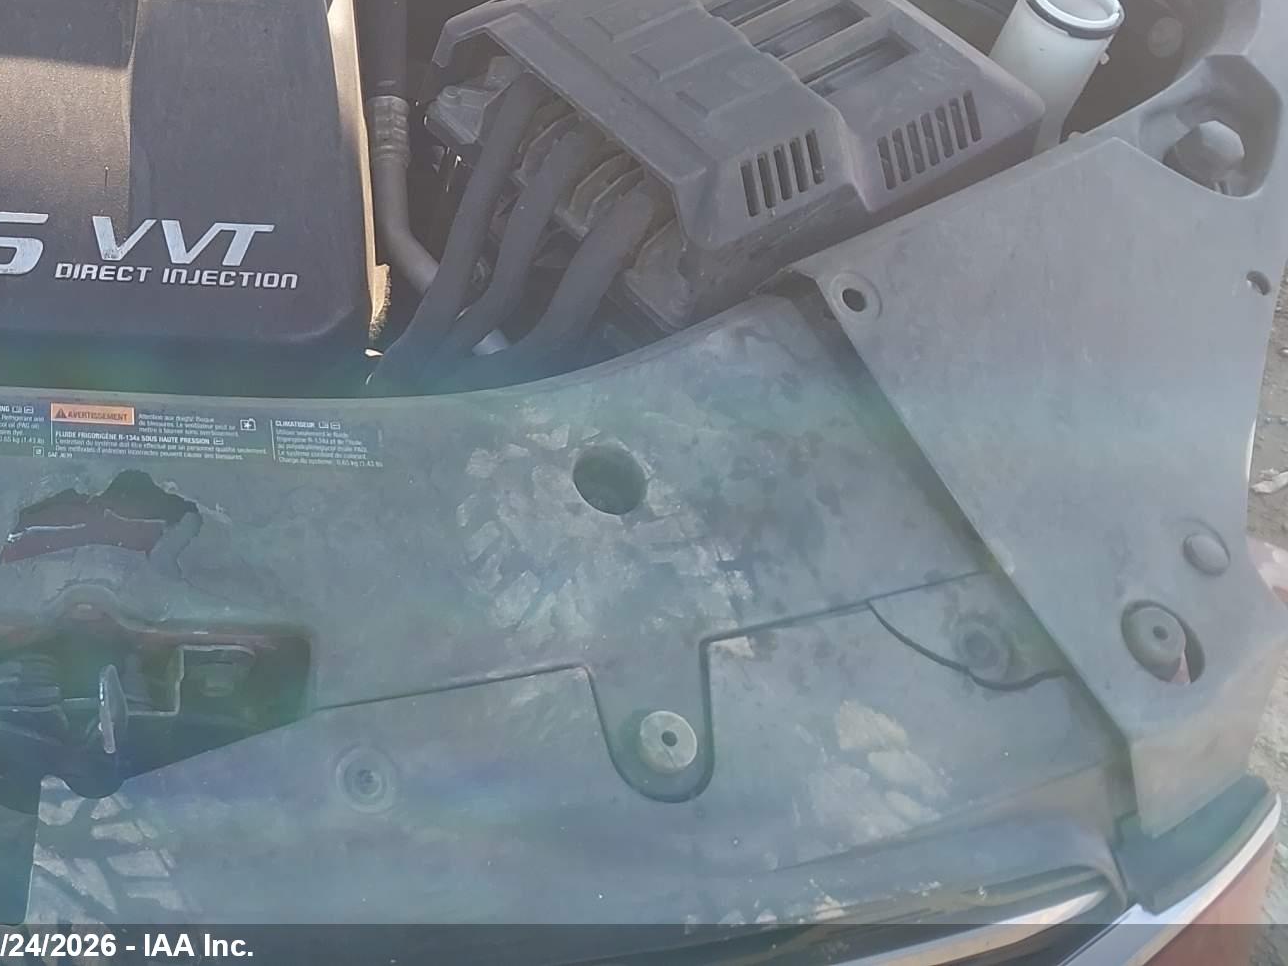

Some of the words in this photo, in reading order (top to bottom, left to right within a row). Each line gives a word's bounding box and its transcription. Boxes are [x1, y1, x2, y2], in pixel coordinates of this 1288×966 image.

[92, 216, 276, 267] VVT
[54, 262, 152, 283] DIRECT
[162, 267, 298, 289] INJECTION
[68, 410, 128, 421] AVERTISSEMENT
[275, 420, 315, 428] CLIMATISEUR
[141, 434, 157, 442] SOUS
[158, 435, 179, 443] HAUTE
[180, 436, 210, 445] PRESSION
